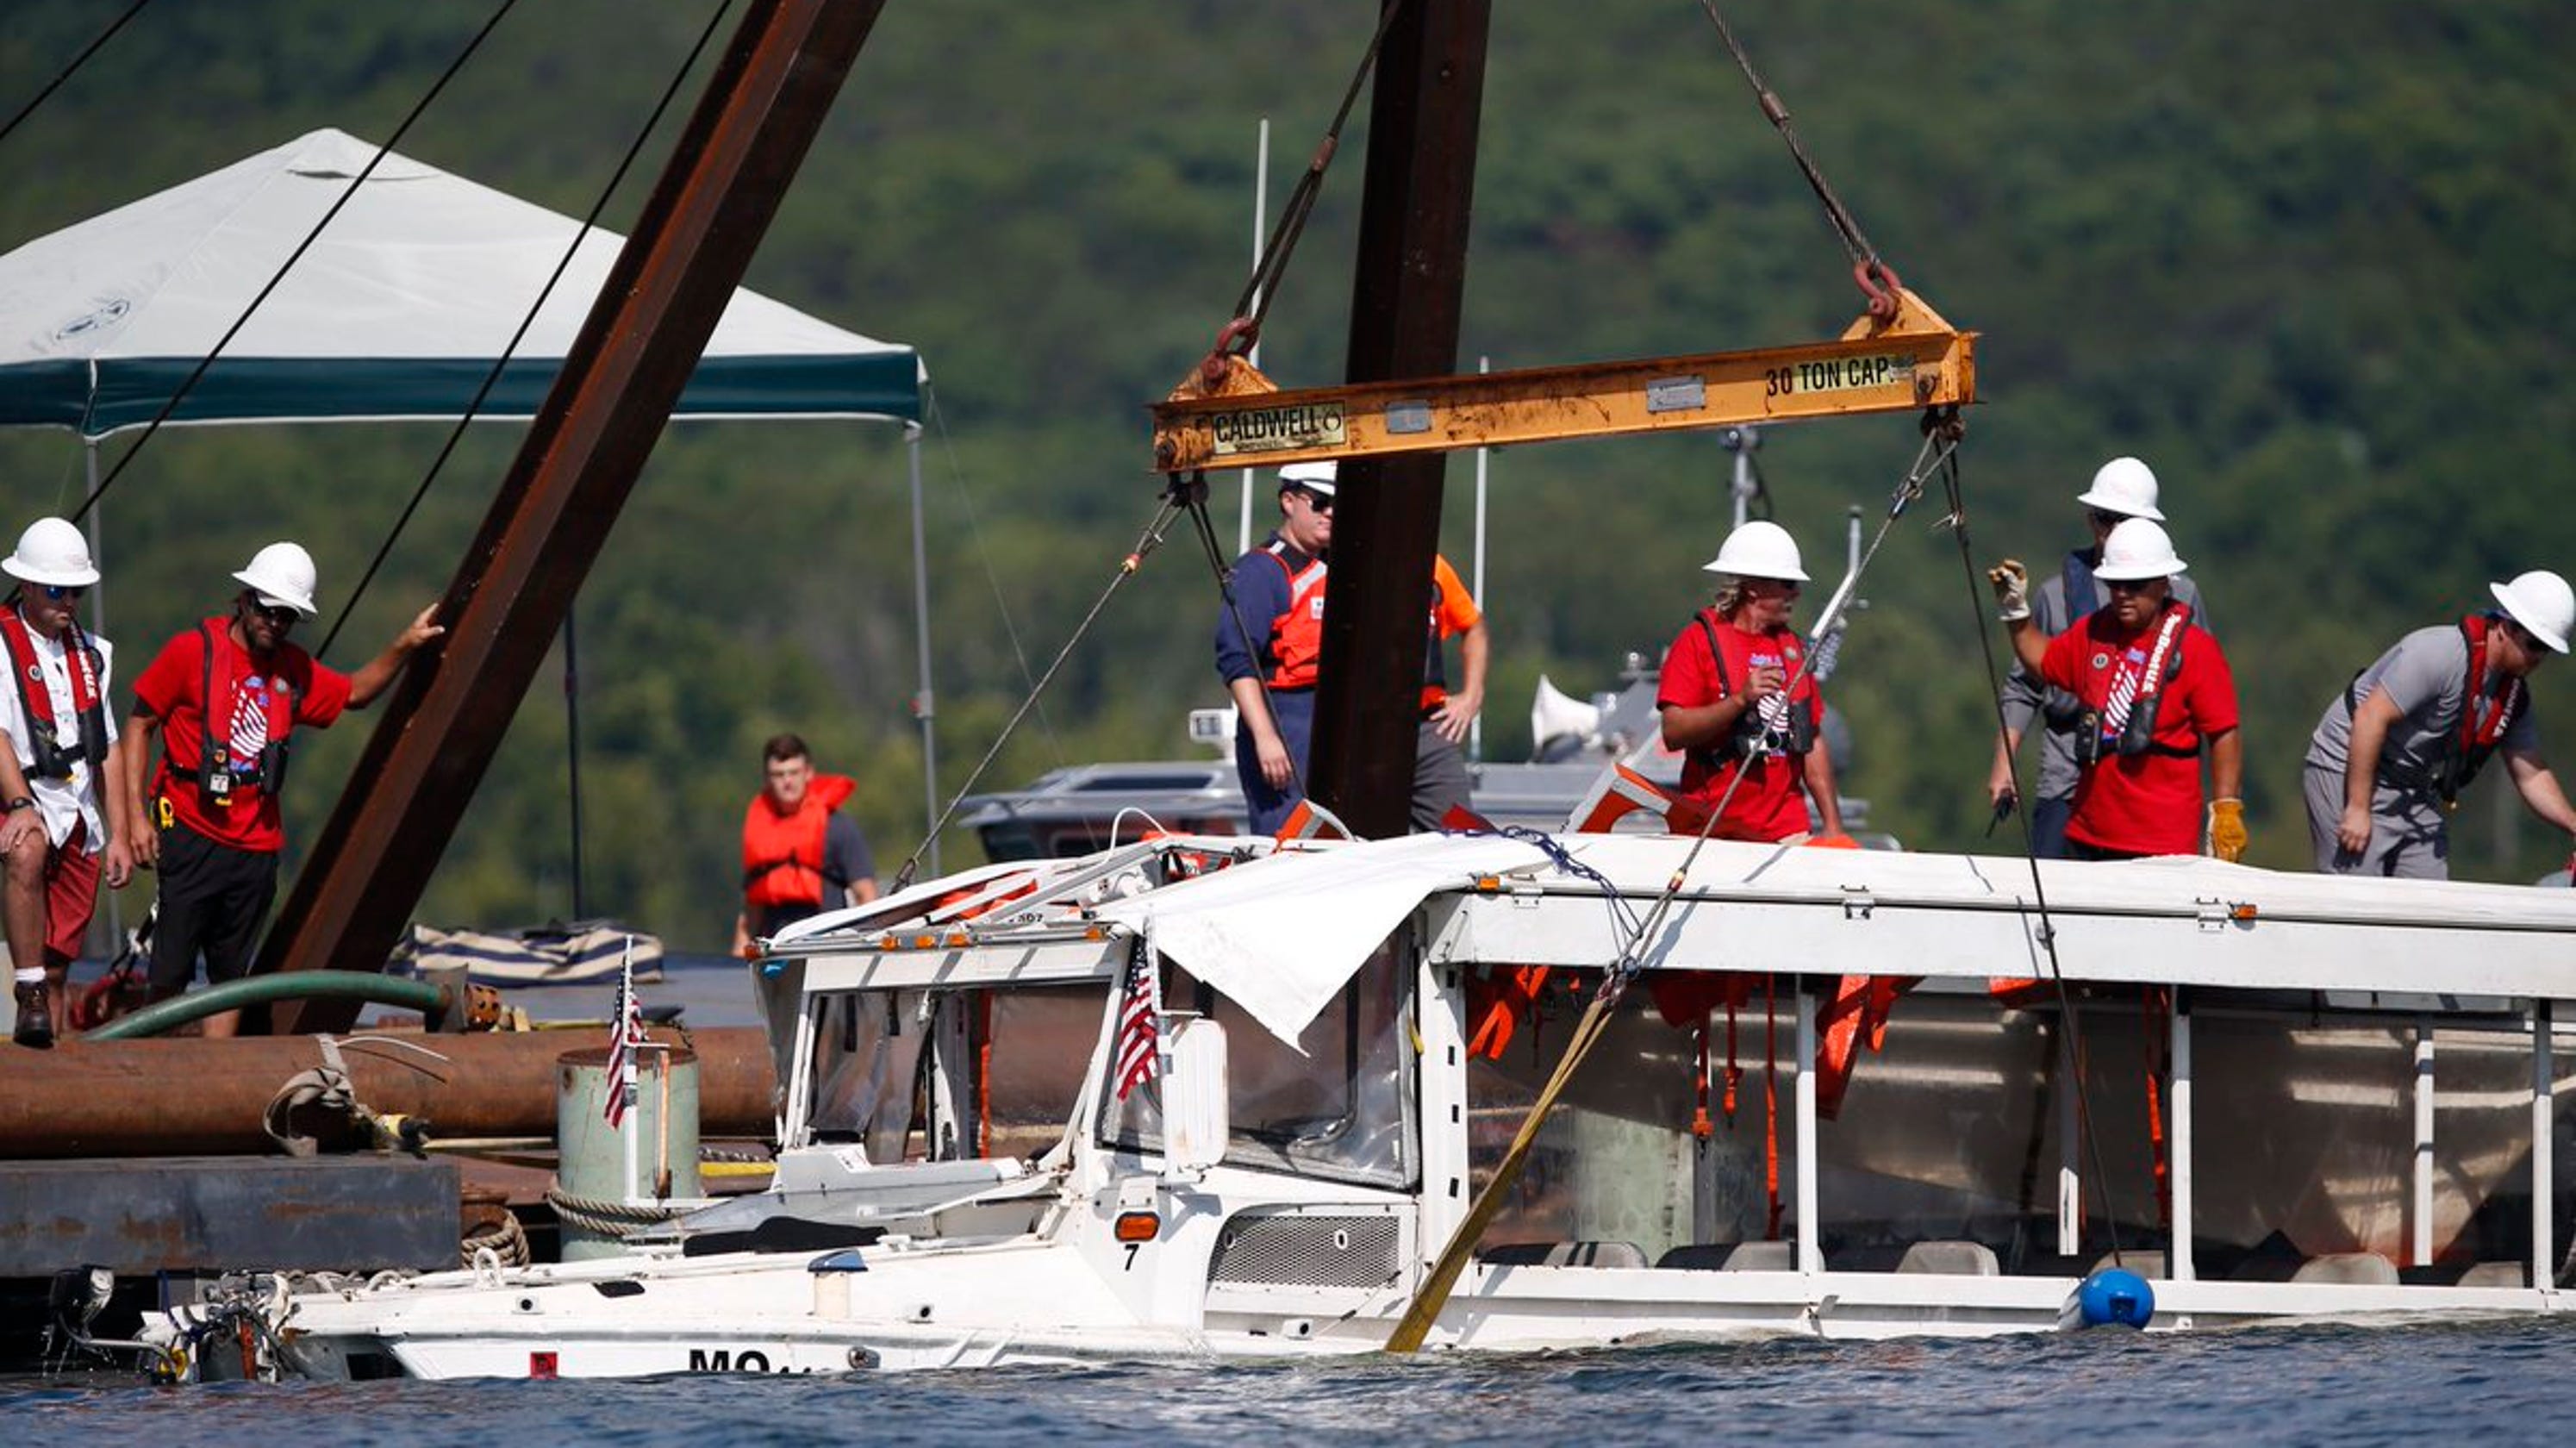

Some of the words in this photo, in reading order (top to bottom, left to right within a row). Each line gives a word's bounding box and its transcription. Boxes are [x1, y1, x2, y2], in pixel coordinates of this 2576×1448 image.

[1767, 367, 1793, 396] 30
[1799, 361, 1841, 390] TON
[1214, 407, 1319, 443] CALDWELL
[1125, 1243, 1139, 1270] 7
